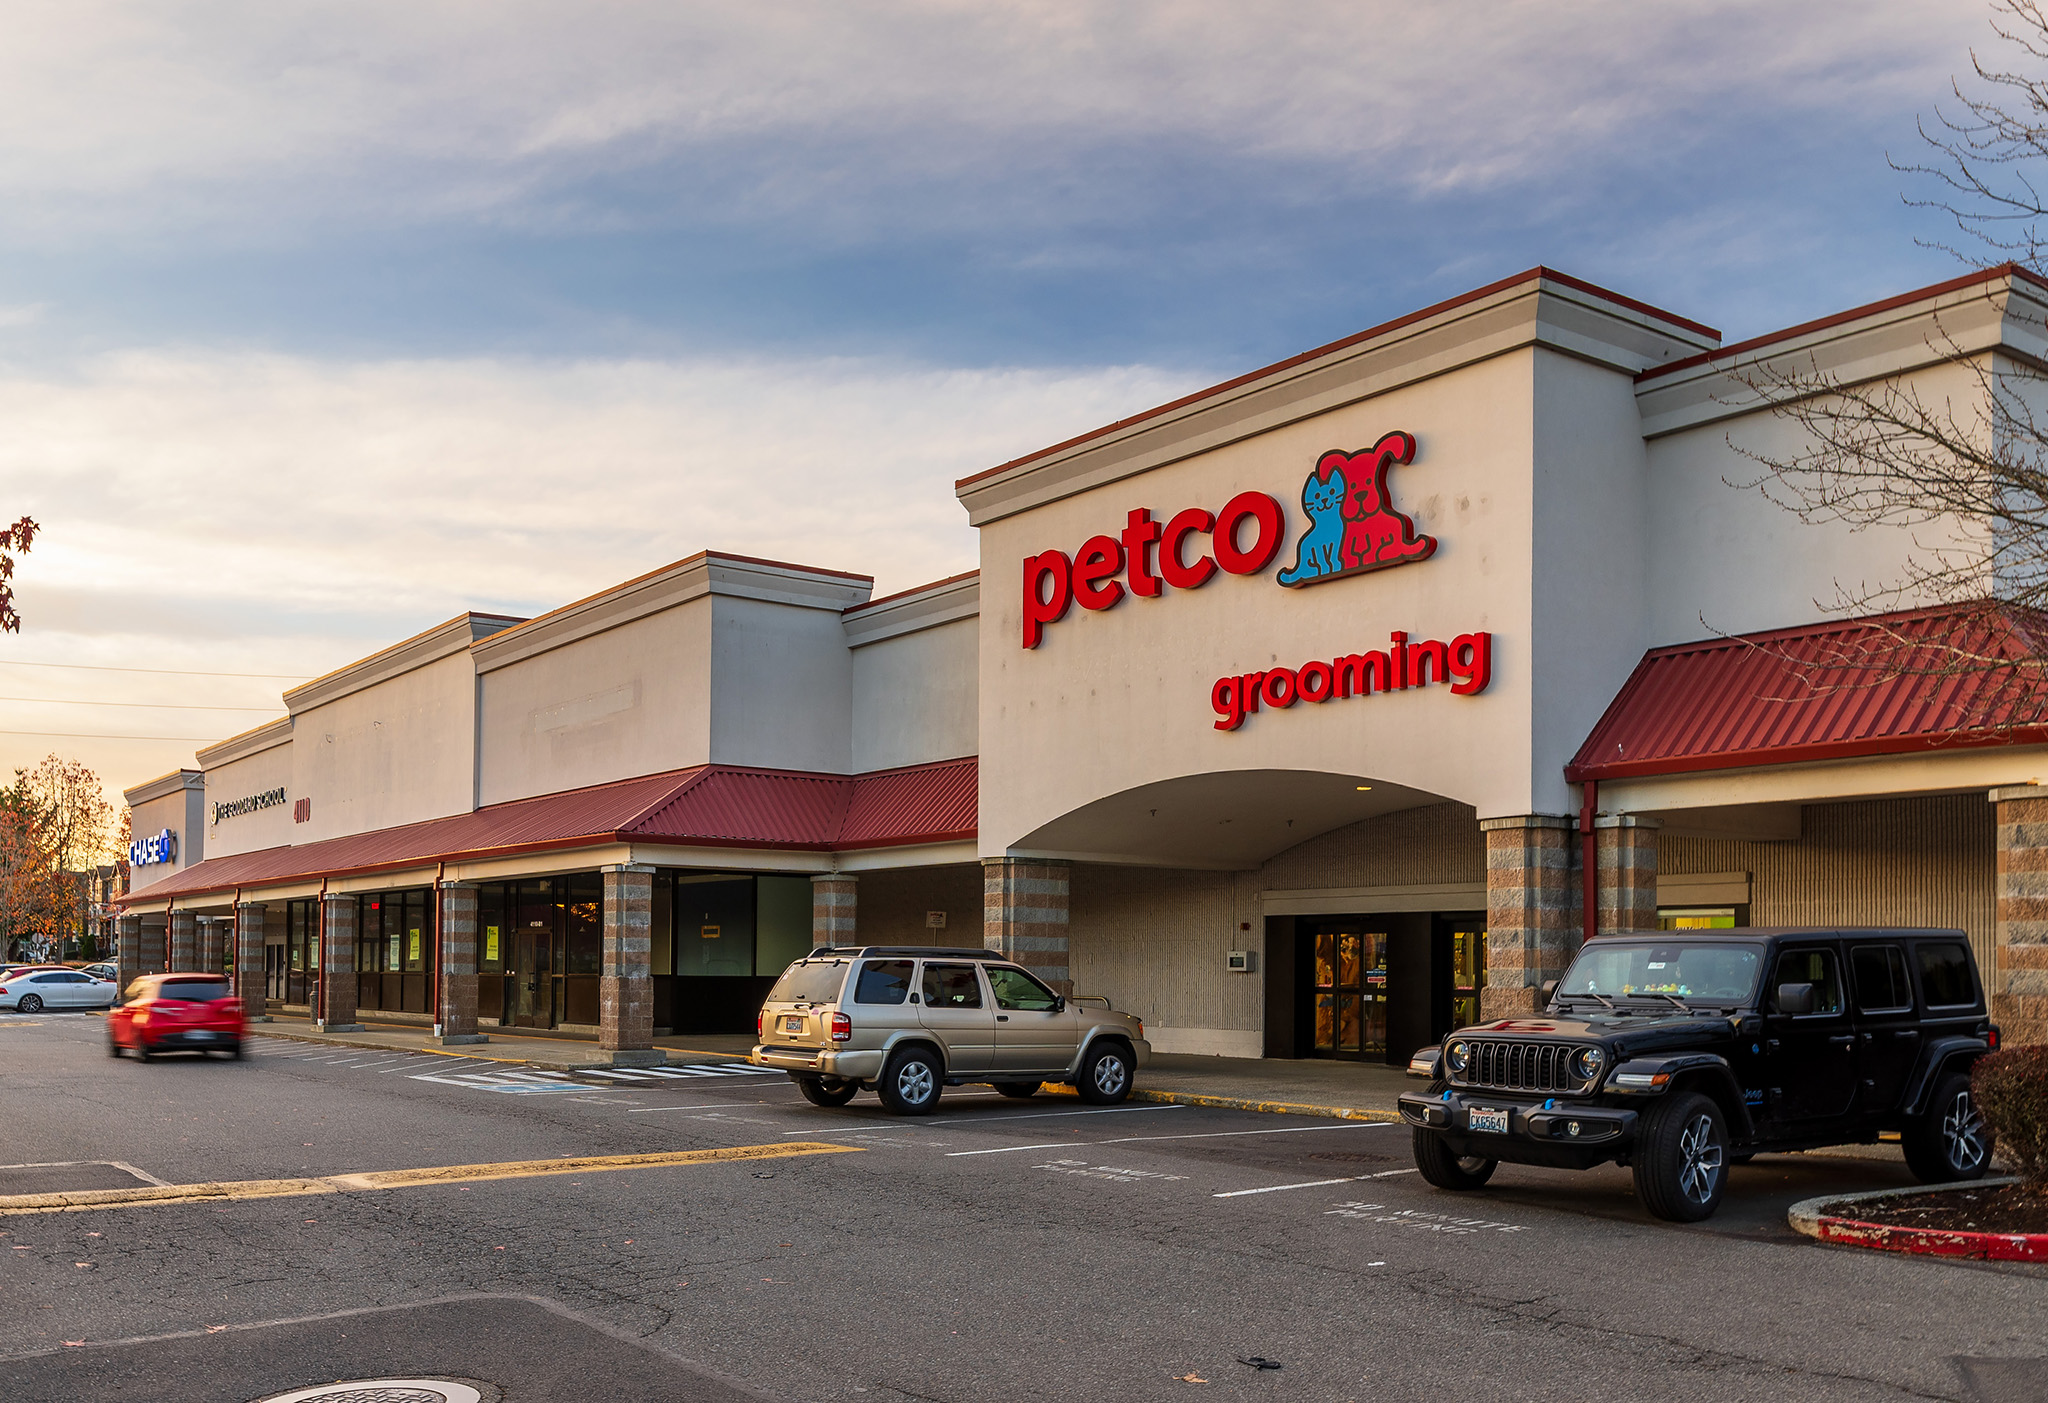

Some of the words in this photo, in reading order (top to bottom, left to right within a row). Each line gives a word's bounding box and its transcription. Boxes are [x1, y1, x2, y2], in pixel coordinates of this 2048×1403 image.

[1022, 490, 1286, 650] petco
[1211, 630, 1492, 731] grooming
[257, 786, 287, 810] SCHOOL
[293, 797, 311, 824] 4110
[129, 834, 161, 867] CHASE
[1470, 1115, 1507, 1130] CKG5647
